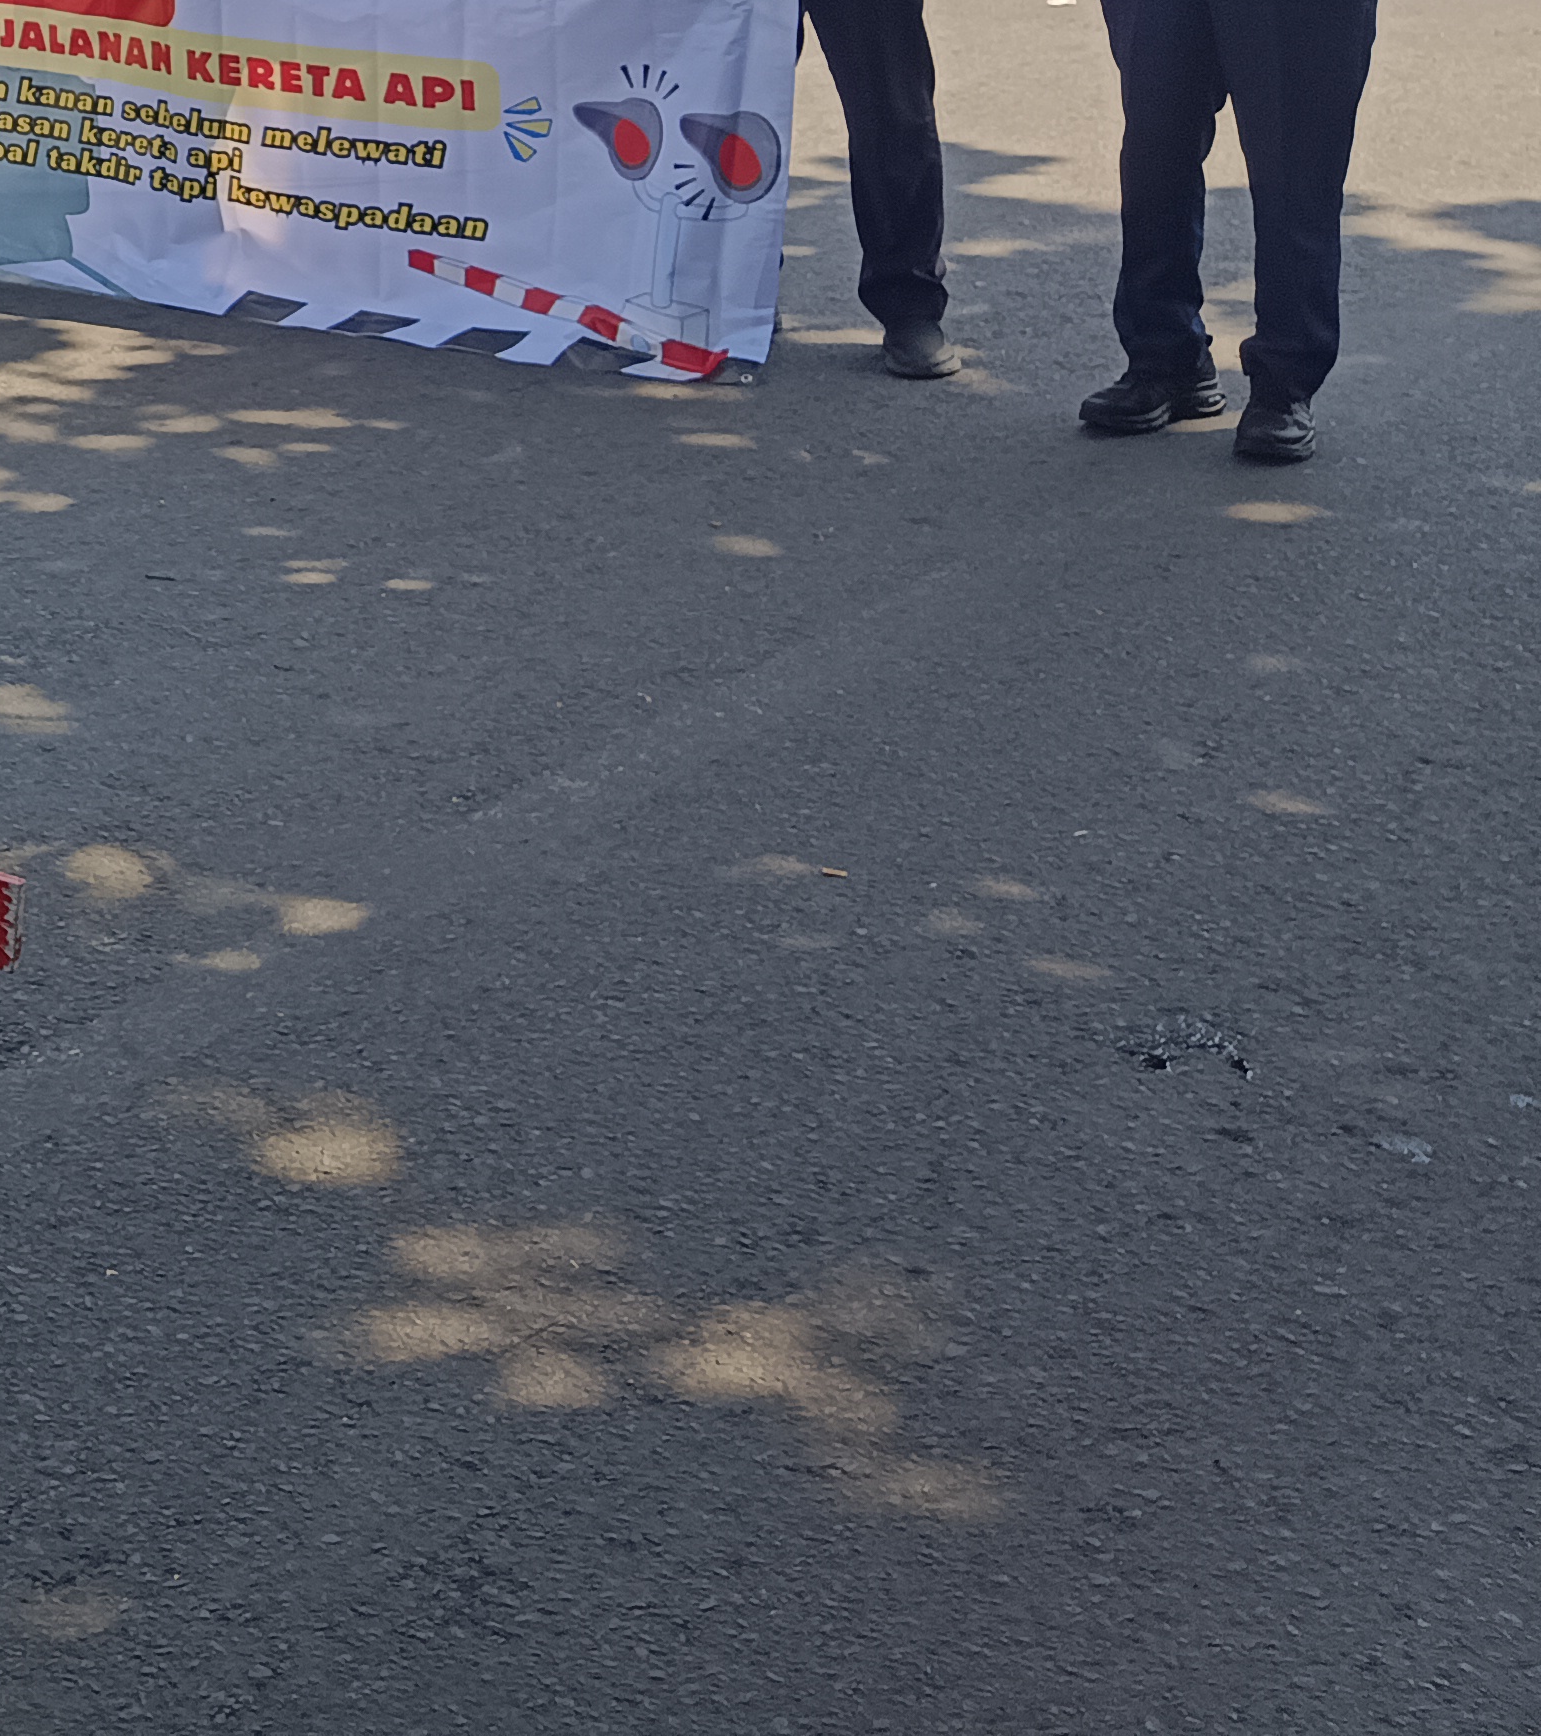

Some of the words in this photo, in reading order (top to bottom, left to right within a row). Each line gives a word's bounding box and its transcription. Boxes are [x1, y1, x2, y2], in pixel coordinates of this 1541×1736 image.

[186, 48, 366, 102] KERETA
[382, 71, 477, 112] API
[16, 75, 115, 117] kanan
[120, 98, 253, 144] sebelum
[261, 126, 447, 168] melewati
[79, 119, 179, 164] kereta
[187, 143, 244, 175] api
[46, 143, 143, 188] takdir
[149, 162, 217, 203] tapi
[227, 175, 490, 242] kewaspadaan
